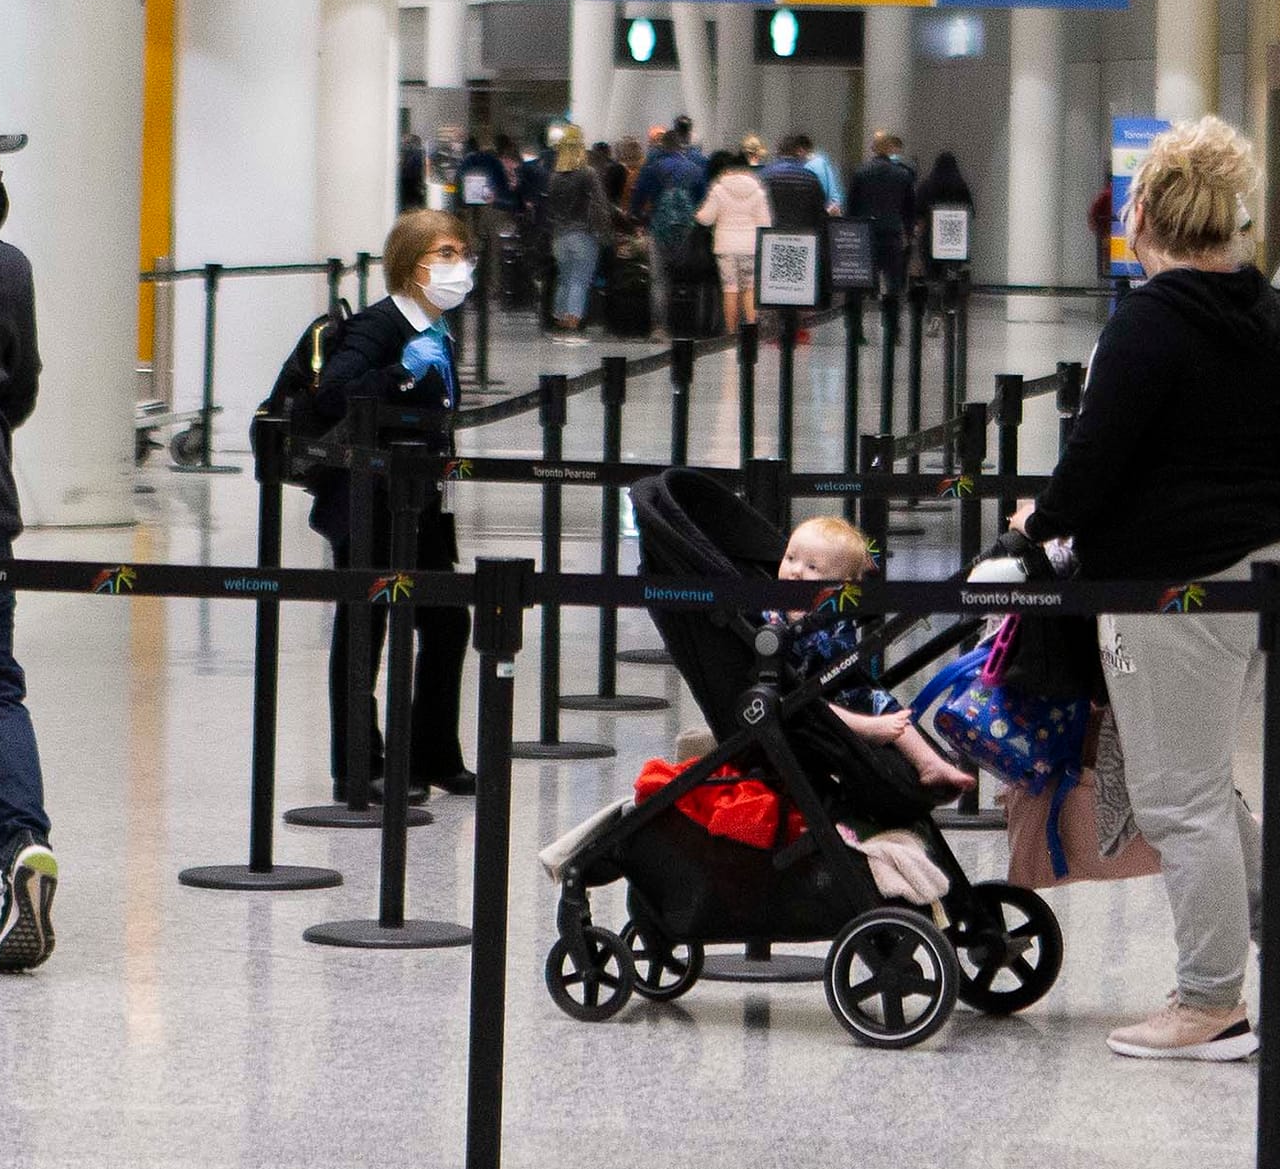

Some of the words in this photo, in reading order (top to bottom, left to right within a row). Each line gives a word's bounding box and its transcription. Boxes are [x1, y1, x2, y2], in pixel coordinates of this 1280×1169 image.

[533, 466, 563, 480] Toronto
[564, 467, 597, 481] Pearson
[814, 480, 862, 492] welcome
[223, 577, 279, 592] welcome
[643, 585, 715, 603] bienvenue
[960, 590, 1009, 605] Toronto
[1010, 591, 1062, 606] Pearson
